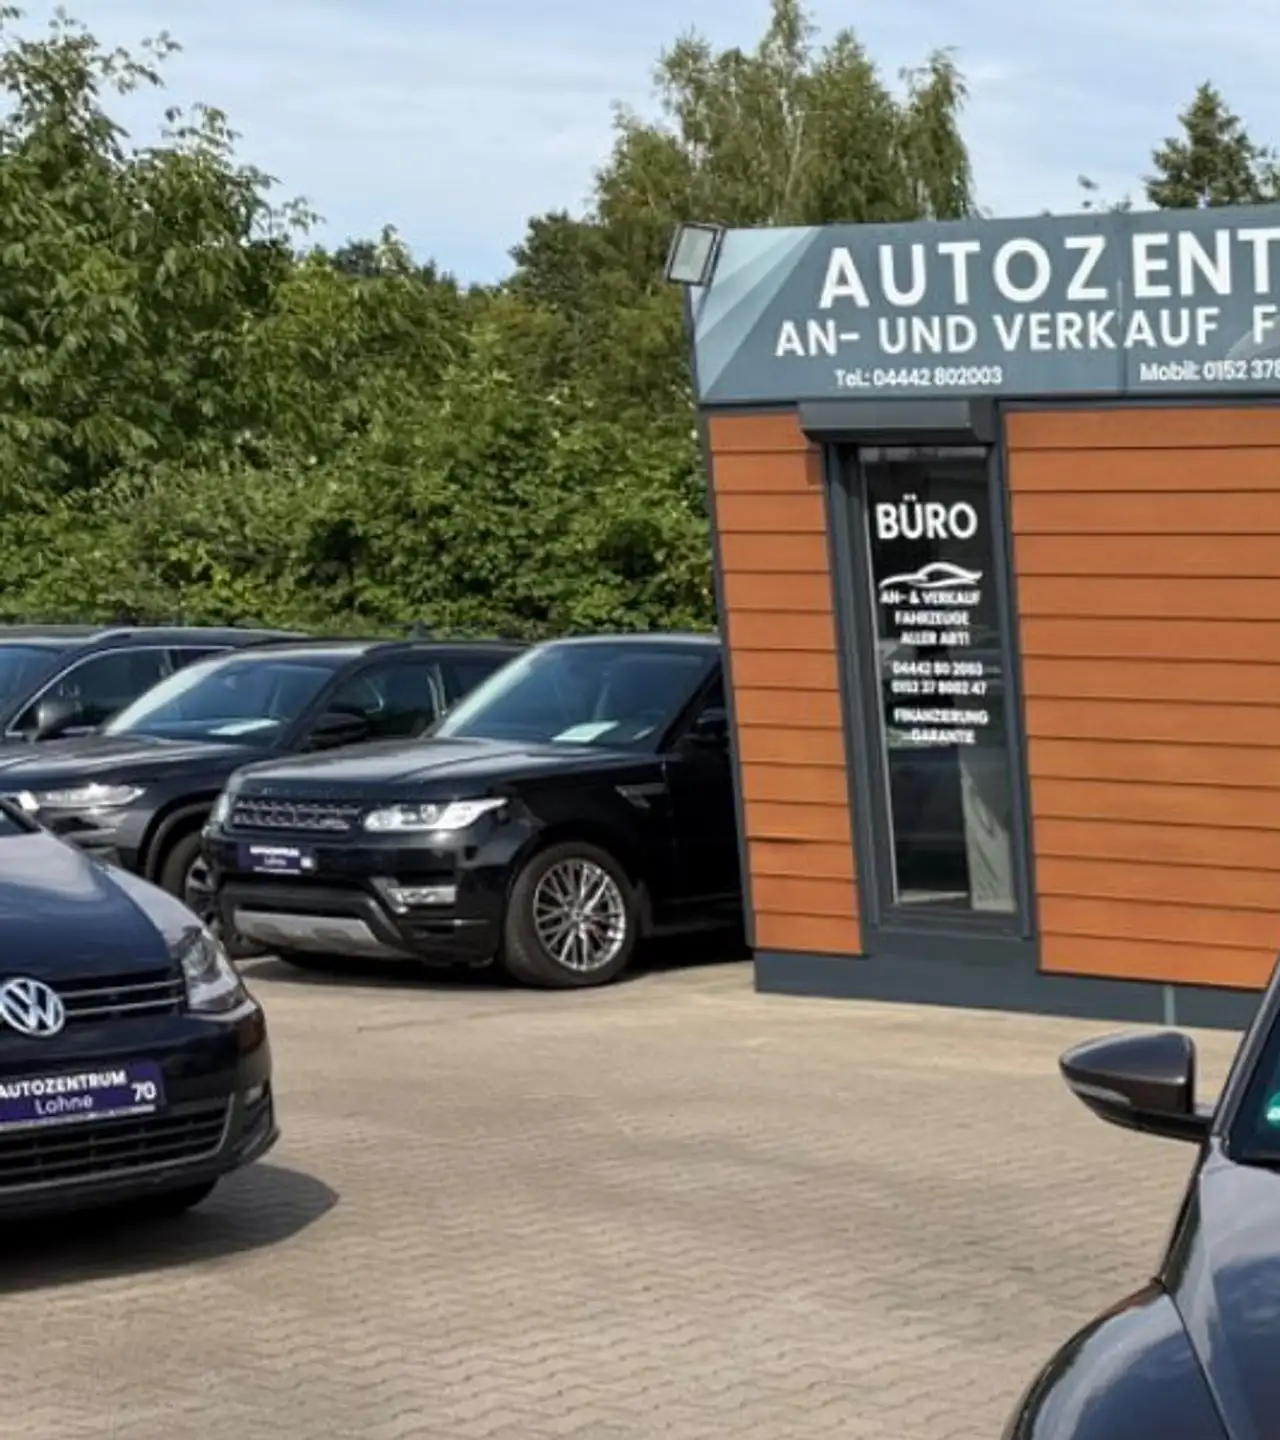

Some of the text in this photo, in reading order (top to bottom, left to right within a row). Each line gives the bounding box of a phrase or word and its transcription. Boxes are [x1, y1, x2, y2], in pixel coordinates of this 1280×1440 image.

[776, 319, 858, 357] AN-
[878, 313, 978, 355] UND
[993, 306, 1220, 352] VERKAUF
[873, 368, 931, 388] 04442
[933, 365, 1003, 386] 802003
[1202, 359, 1249, 380] 0152
[875, 492, 978, 539] BÜRO
[921, 590, 981, 606] VERKAUF
[895, 610, 969, 625] FAHRZEUGE
[901, 630, 938, 645] ALLER
[911, 728, 976, 745] GARANTIE
[130, 1080, 157, 1103] 70
[34, 1094, 94, 1116] Lohne
